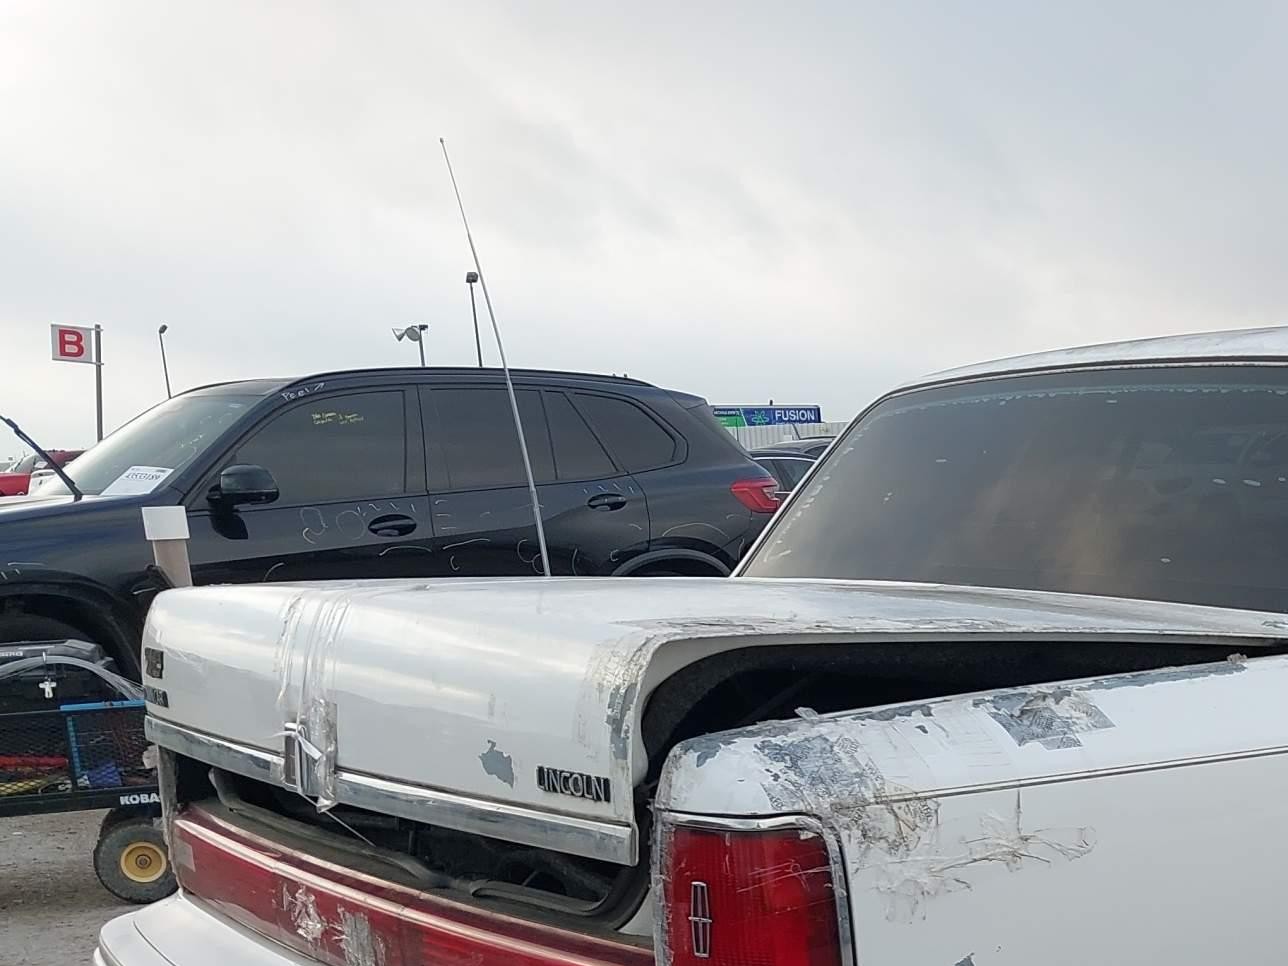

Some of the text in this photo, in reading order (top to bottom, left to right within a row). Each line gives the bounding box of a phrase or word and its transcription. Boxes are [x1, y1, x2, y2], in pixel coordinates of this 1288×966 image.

[58, 329, 85, 358] B
[774, 409, 815, 421] FUSION
[536, 766, 608, 803] LINCOLN
[119, 792, 161, 805] KOBA
